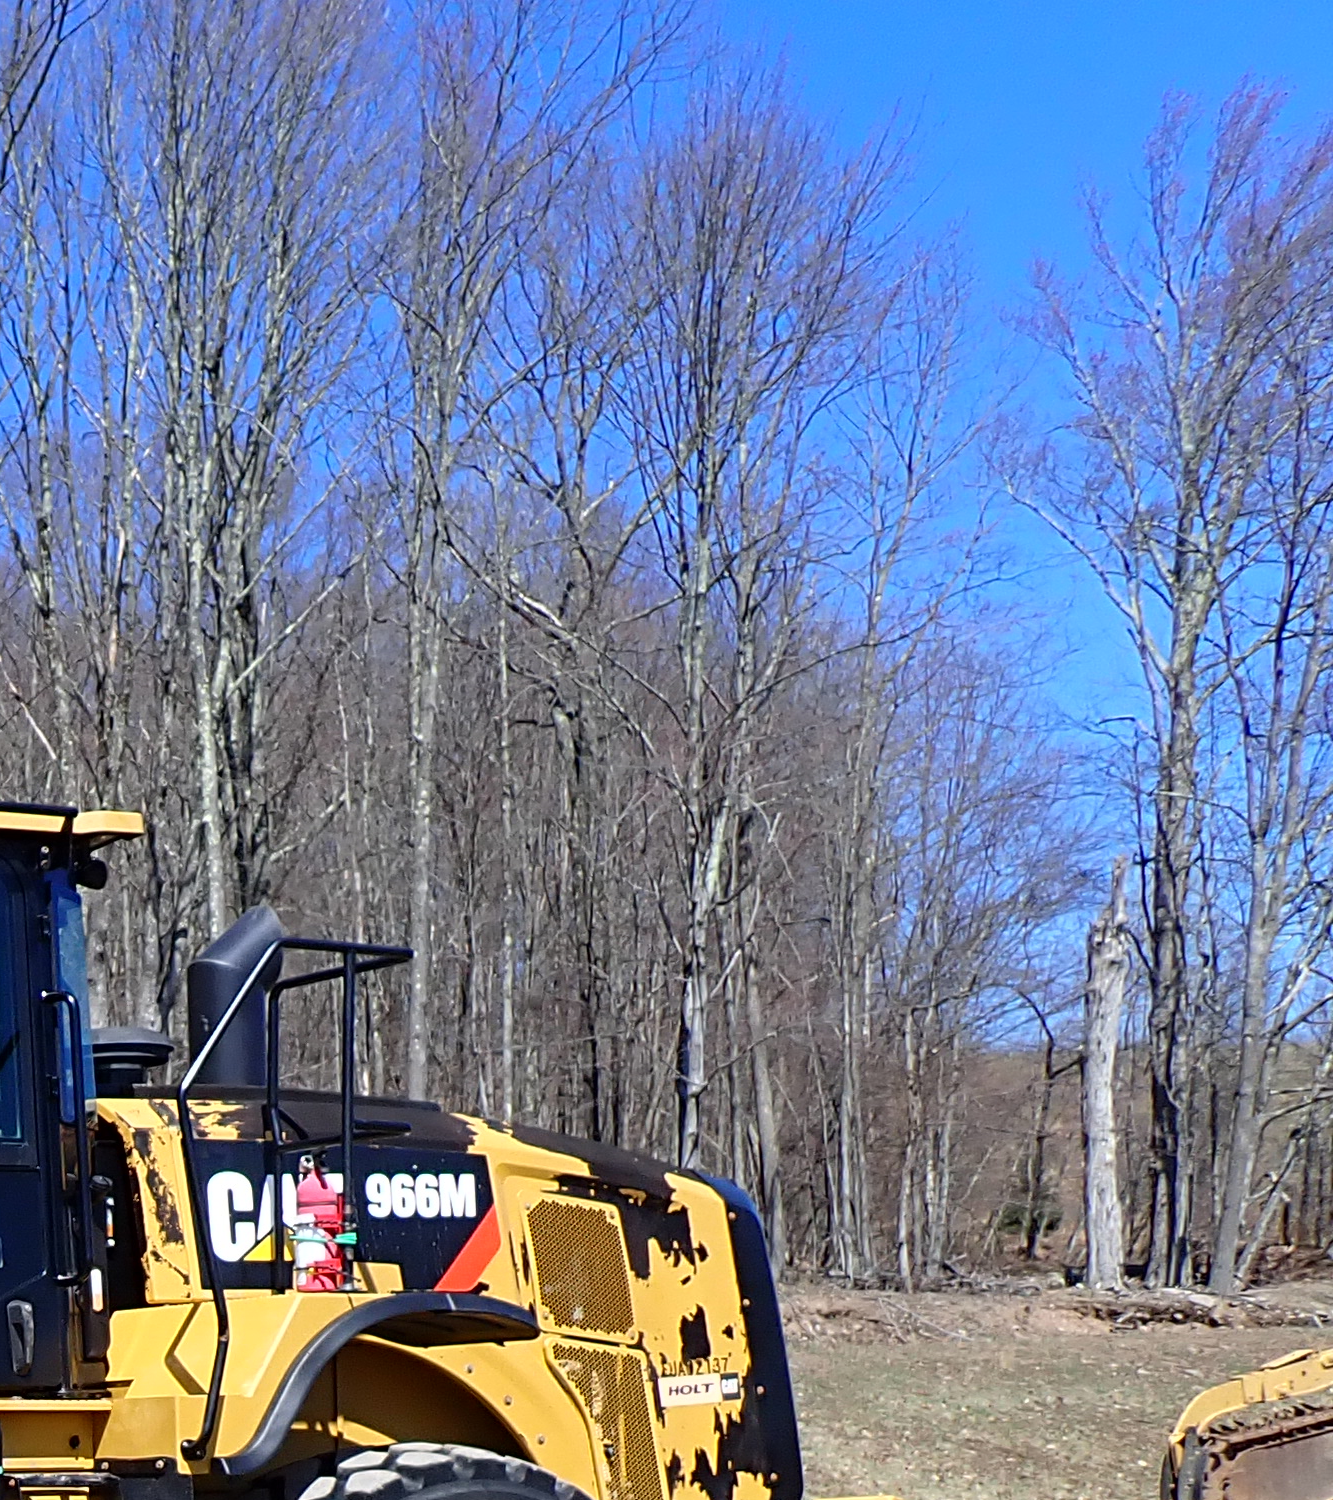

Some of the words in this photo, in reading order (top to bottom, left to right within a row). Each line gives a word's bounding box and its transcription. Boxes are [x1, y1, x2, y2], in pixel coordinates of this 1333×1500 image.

[207, 1171, 343, 1262] CA
[365, 1173, 477, 1218] 966M
[668, 1382, 714, 1396] HOLT
